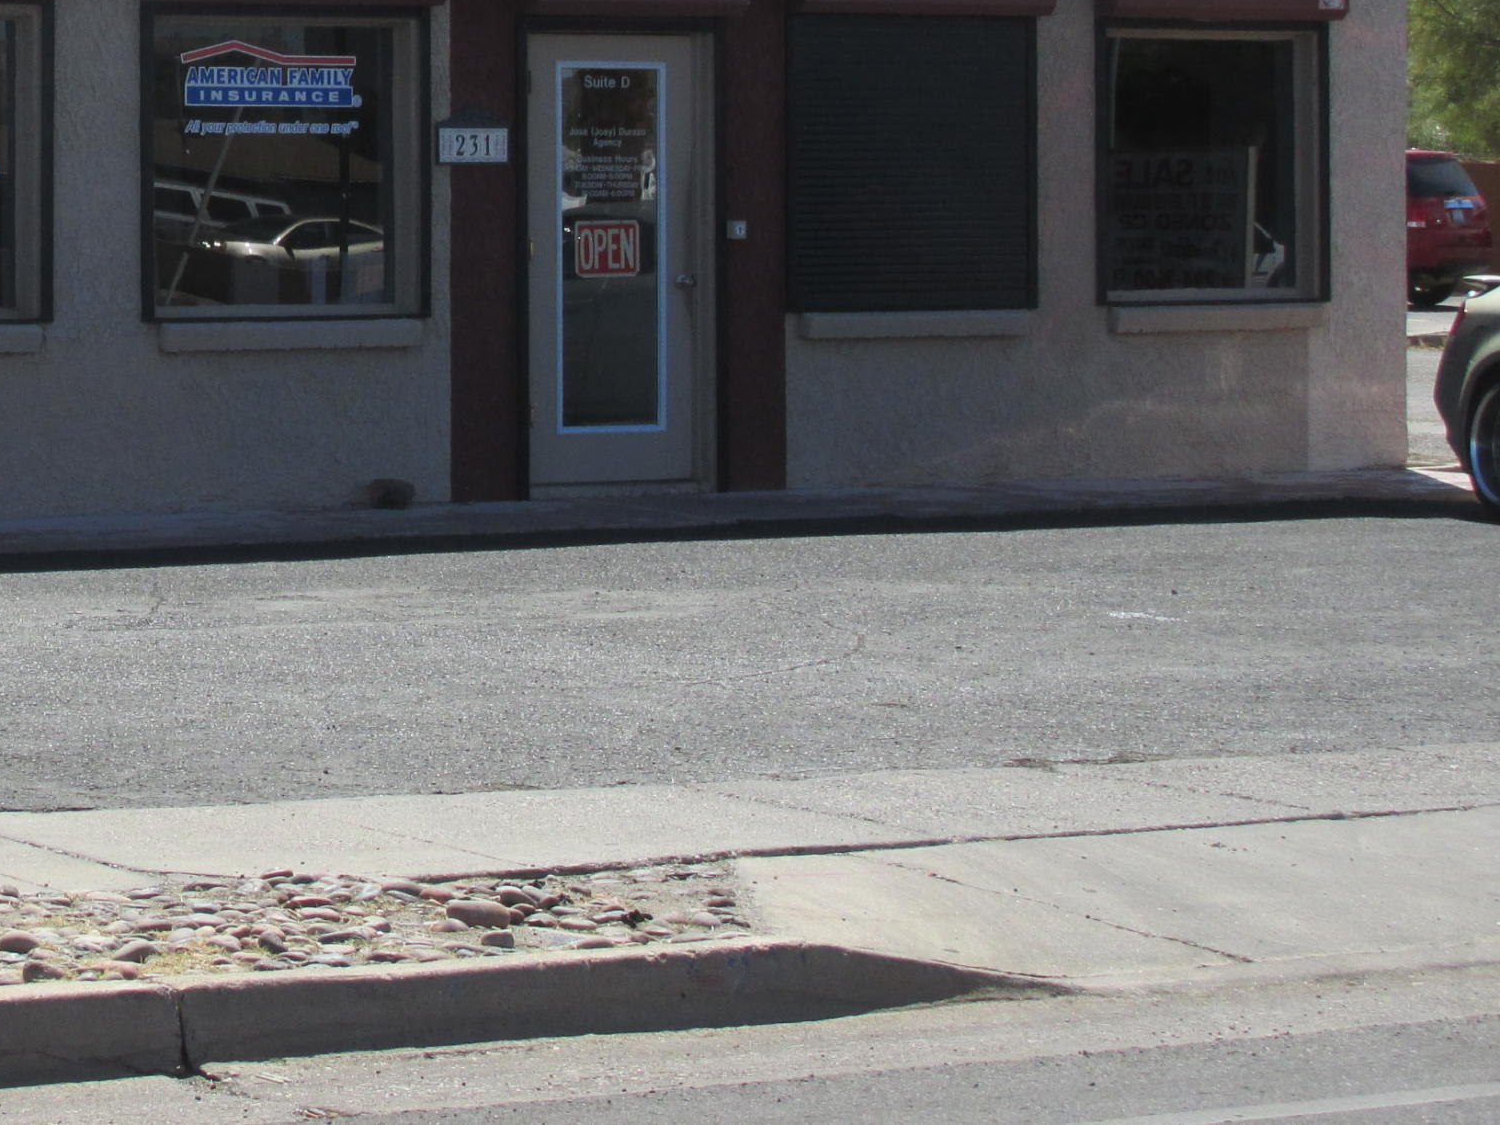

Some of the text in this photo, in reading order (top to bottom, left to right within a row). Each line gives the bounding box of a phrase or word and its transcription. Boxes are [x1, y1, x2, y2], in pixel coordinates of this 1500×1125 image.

[187, 66, 353, 87] AMERICAN FAMILY
[584, 75, 630, 88] Suite D
[200, 90, 339, 103] INSURANCE
[185, 120, 201, 134] All
[201, 122, 226, 136] your
[225, 120, 278, 136] protection
[278, 121, 310, 134] under
[310, 122, 330, 134] one
[455, 134, 491, 156] 231
[593, 137, 622, 148] Agency
[579, 227, 635, 270] OPEN
